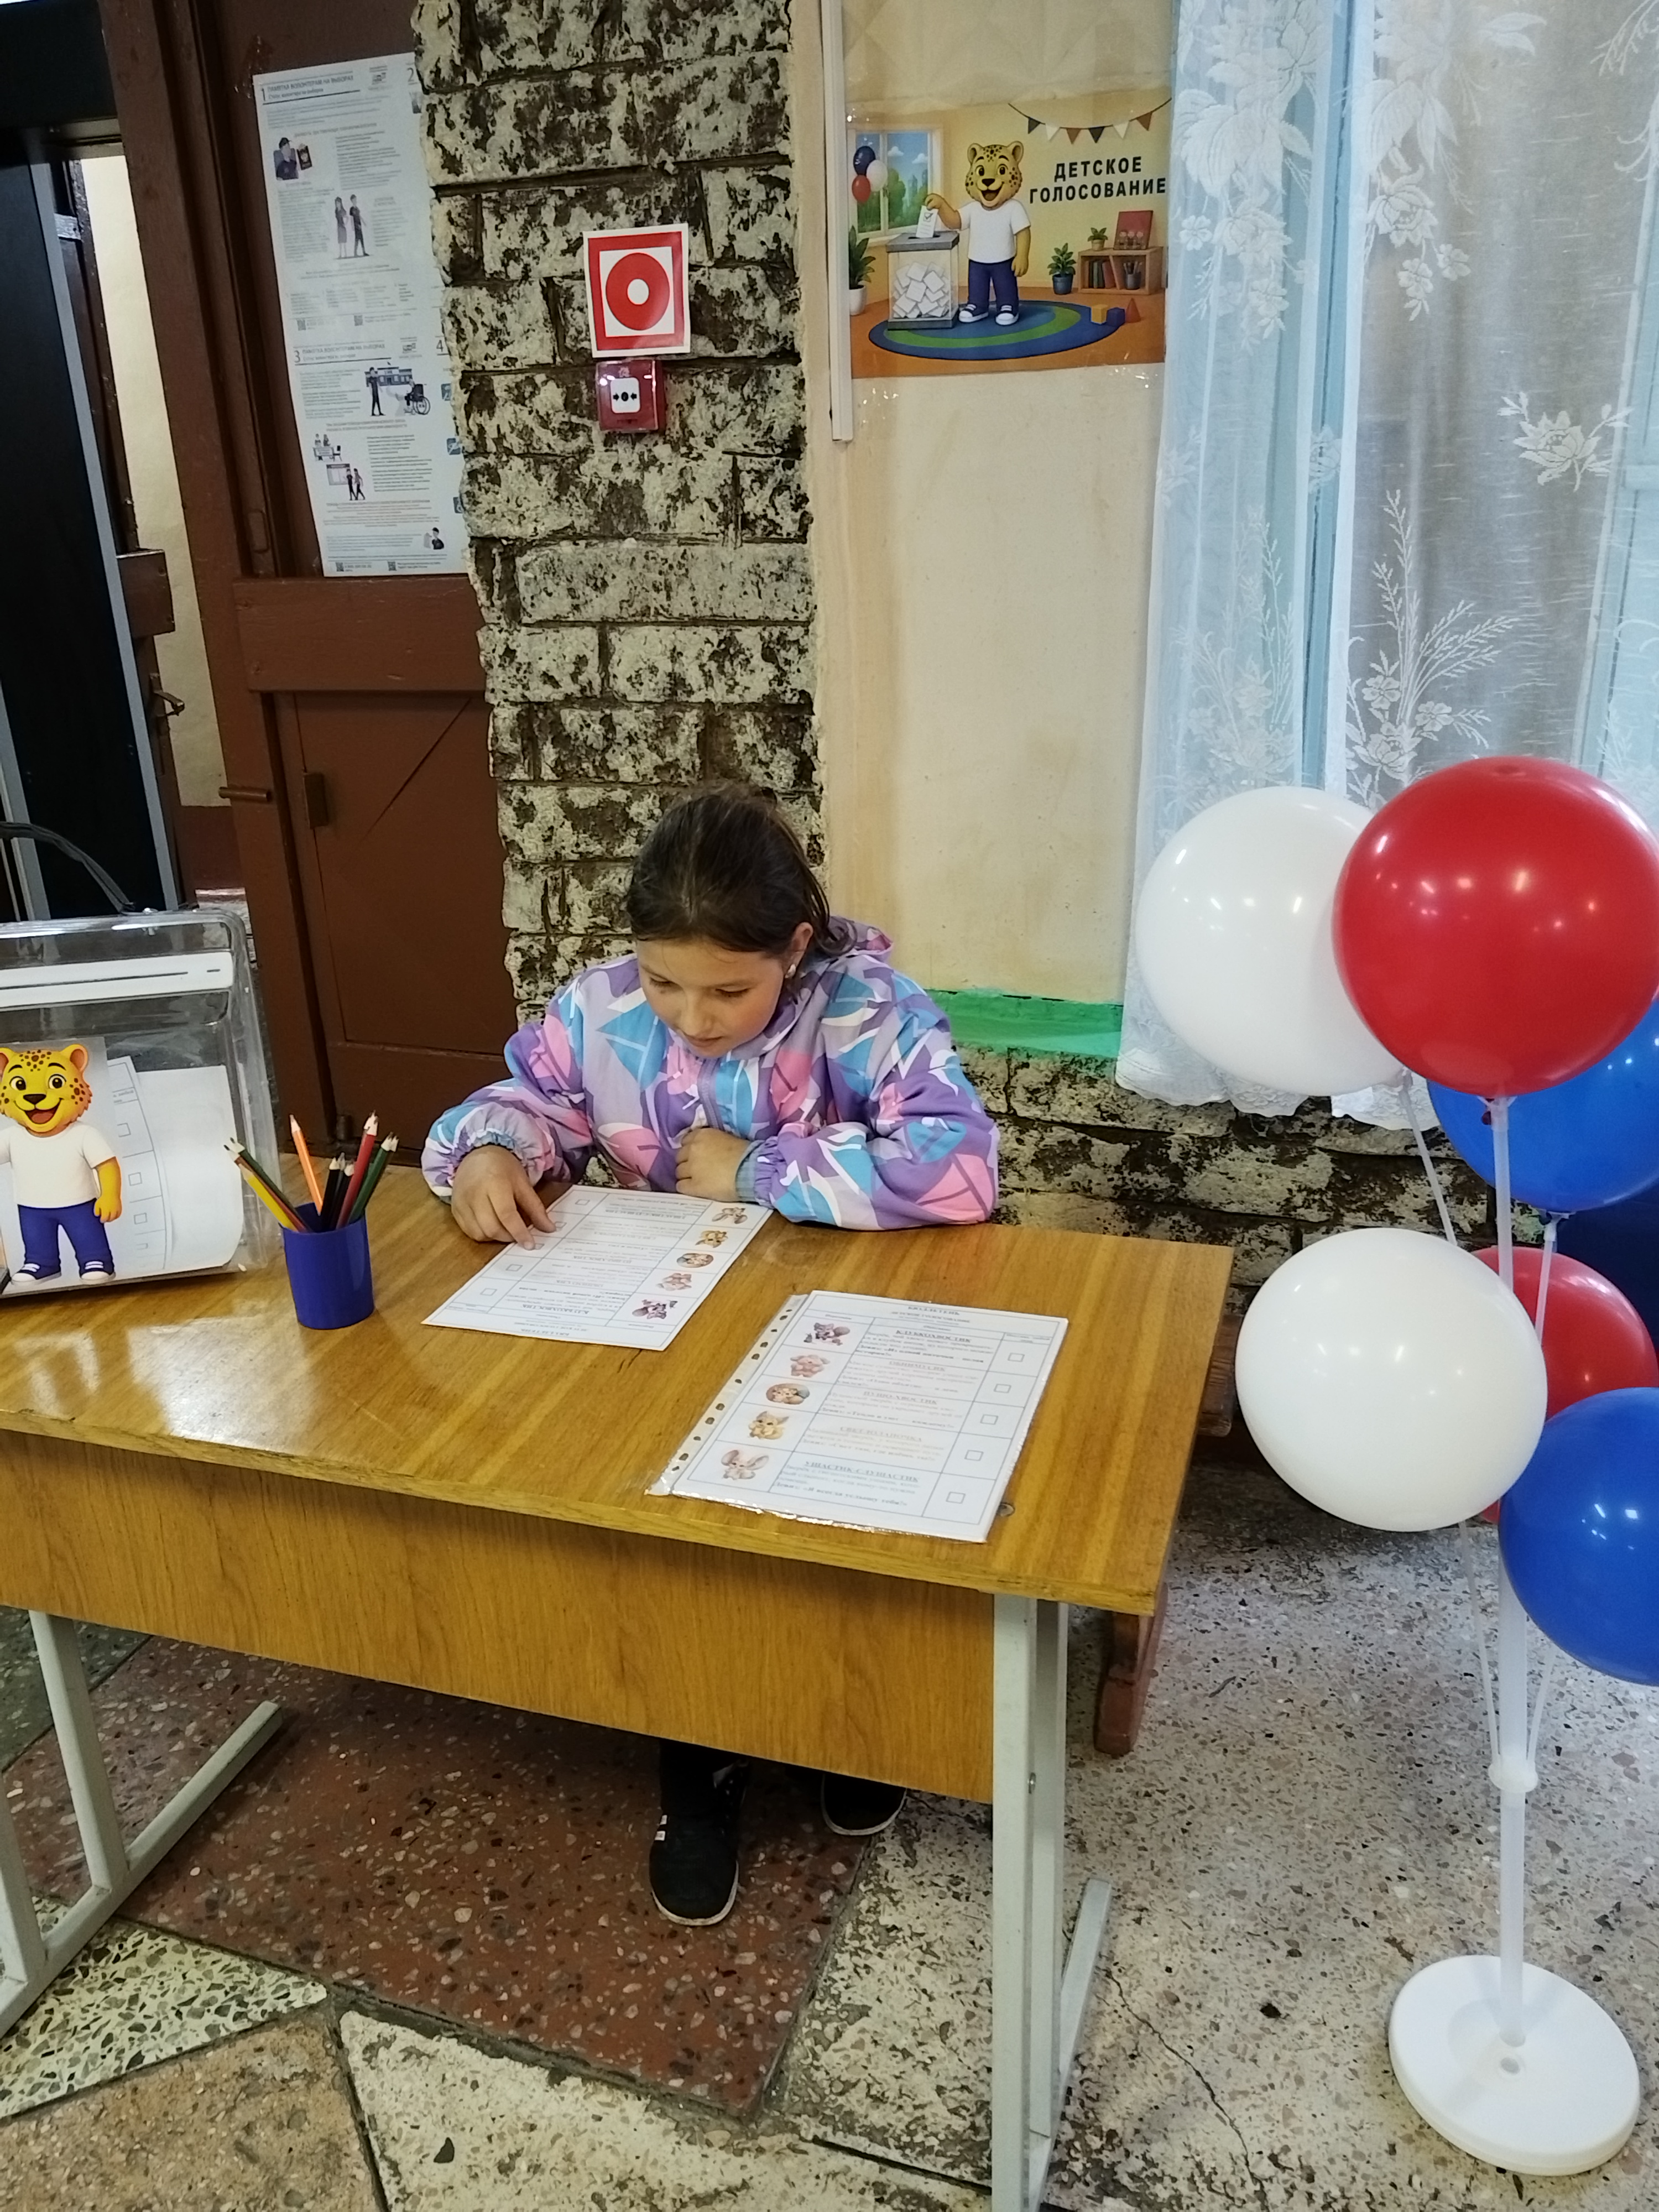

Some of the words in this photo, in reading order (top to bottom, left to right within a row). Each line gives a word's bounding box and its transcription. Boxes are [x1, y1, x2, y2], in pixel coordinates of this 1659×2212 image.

[261, 87, 265, 101] 1
[1054, 156, 1141, 182] ДЕТСКОЕ
[1030, 178, 1166, 204] ГОЛОСОВАНИЕ
[436, 340, 444, 352] 4
[294, 350, 300, 363] 3
